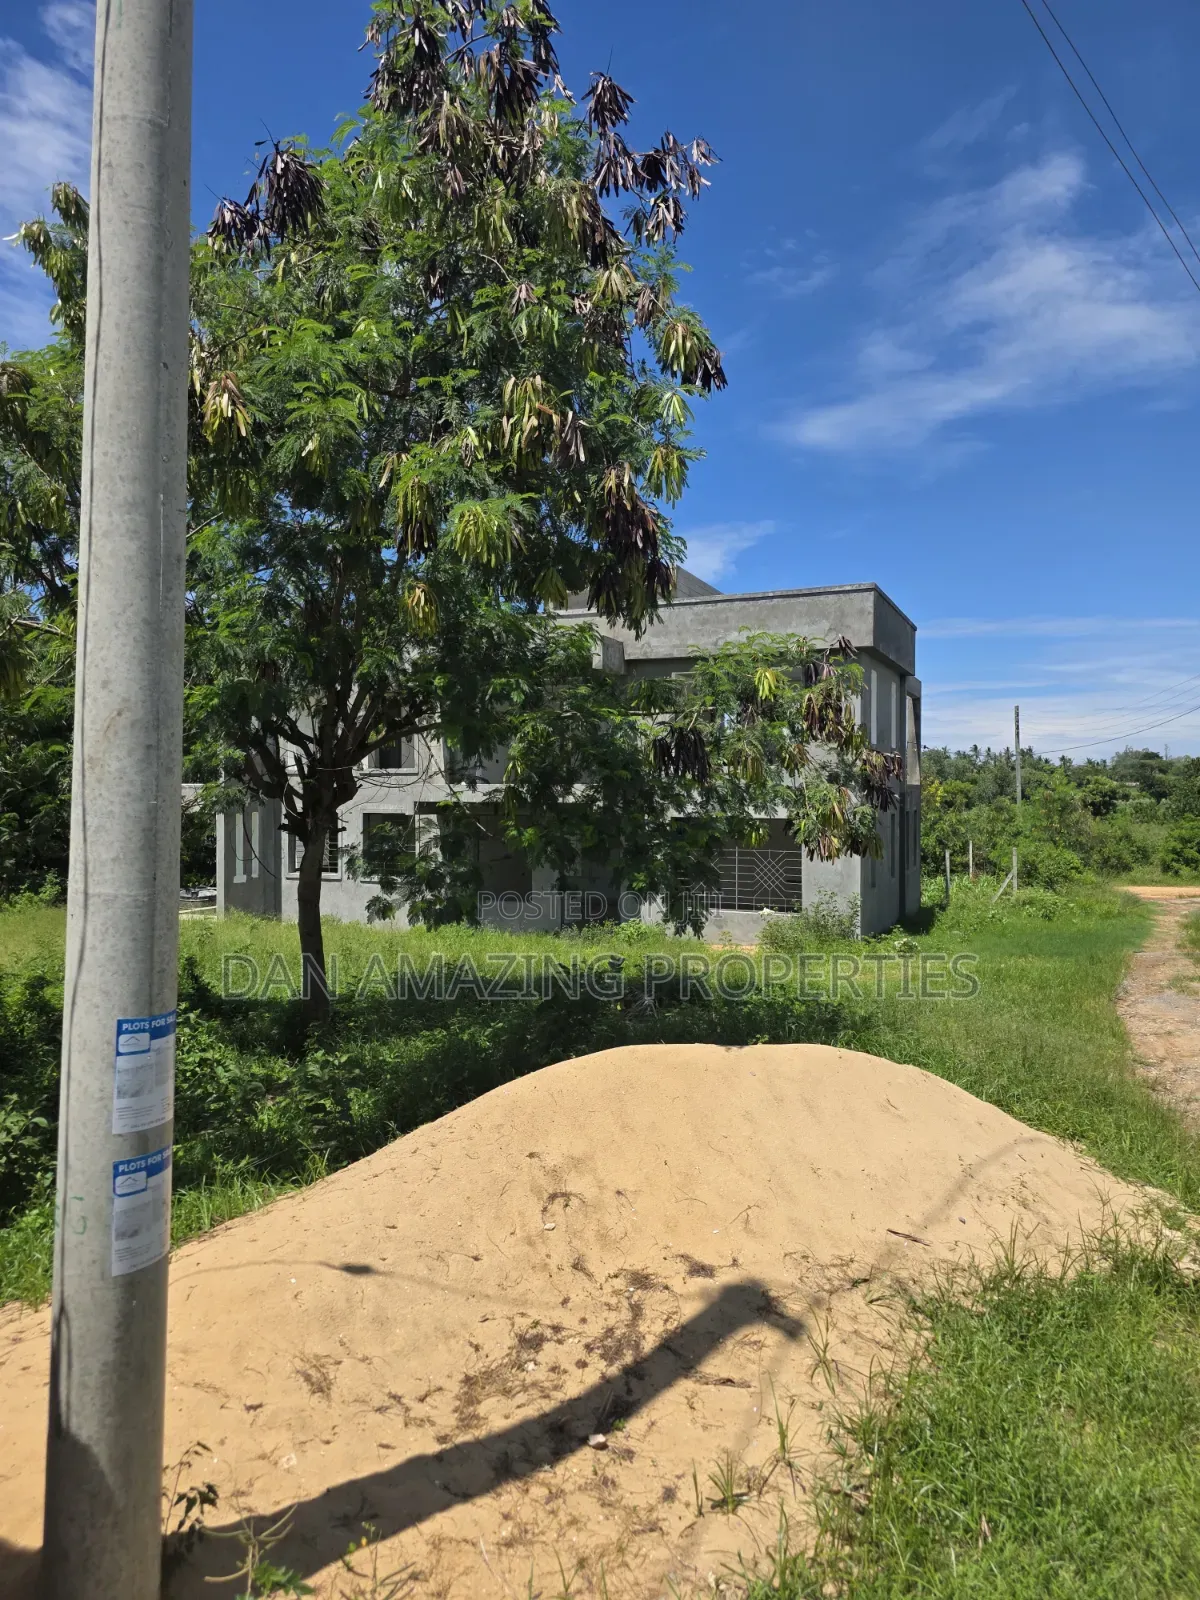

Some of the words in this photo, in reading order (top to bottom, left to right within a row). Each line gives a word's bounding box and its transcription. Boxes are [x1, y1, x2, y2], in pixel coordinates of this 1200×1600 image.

[122, 1021, 150, 1031] PLOTS
[151, 1017, 166, 1029] FOR
[118, 1160, 146, 1173] PLOTS
[147, 1153, 162, 1166] FOR
